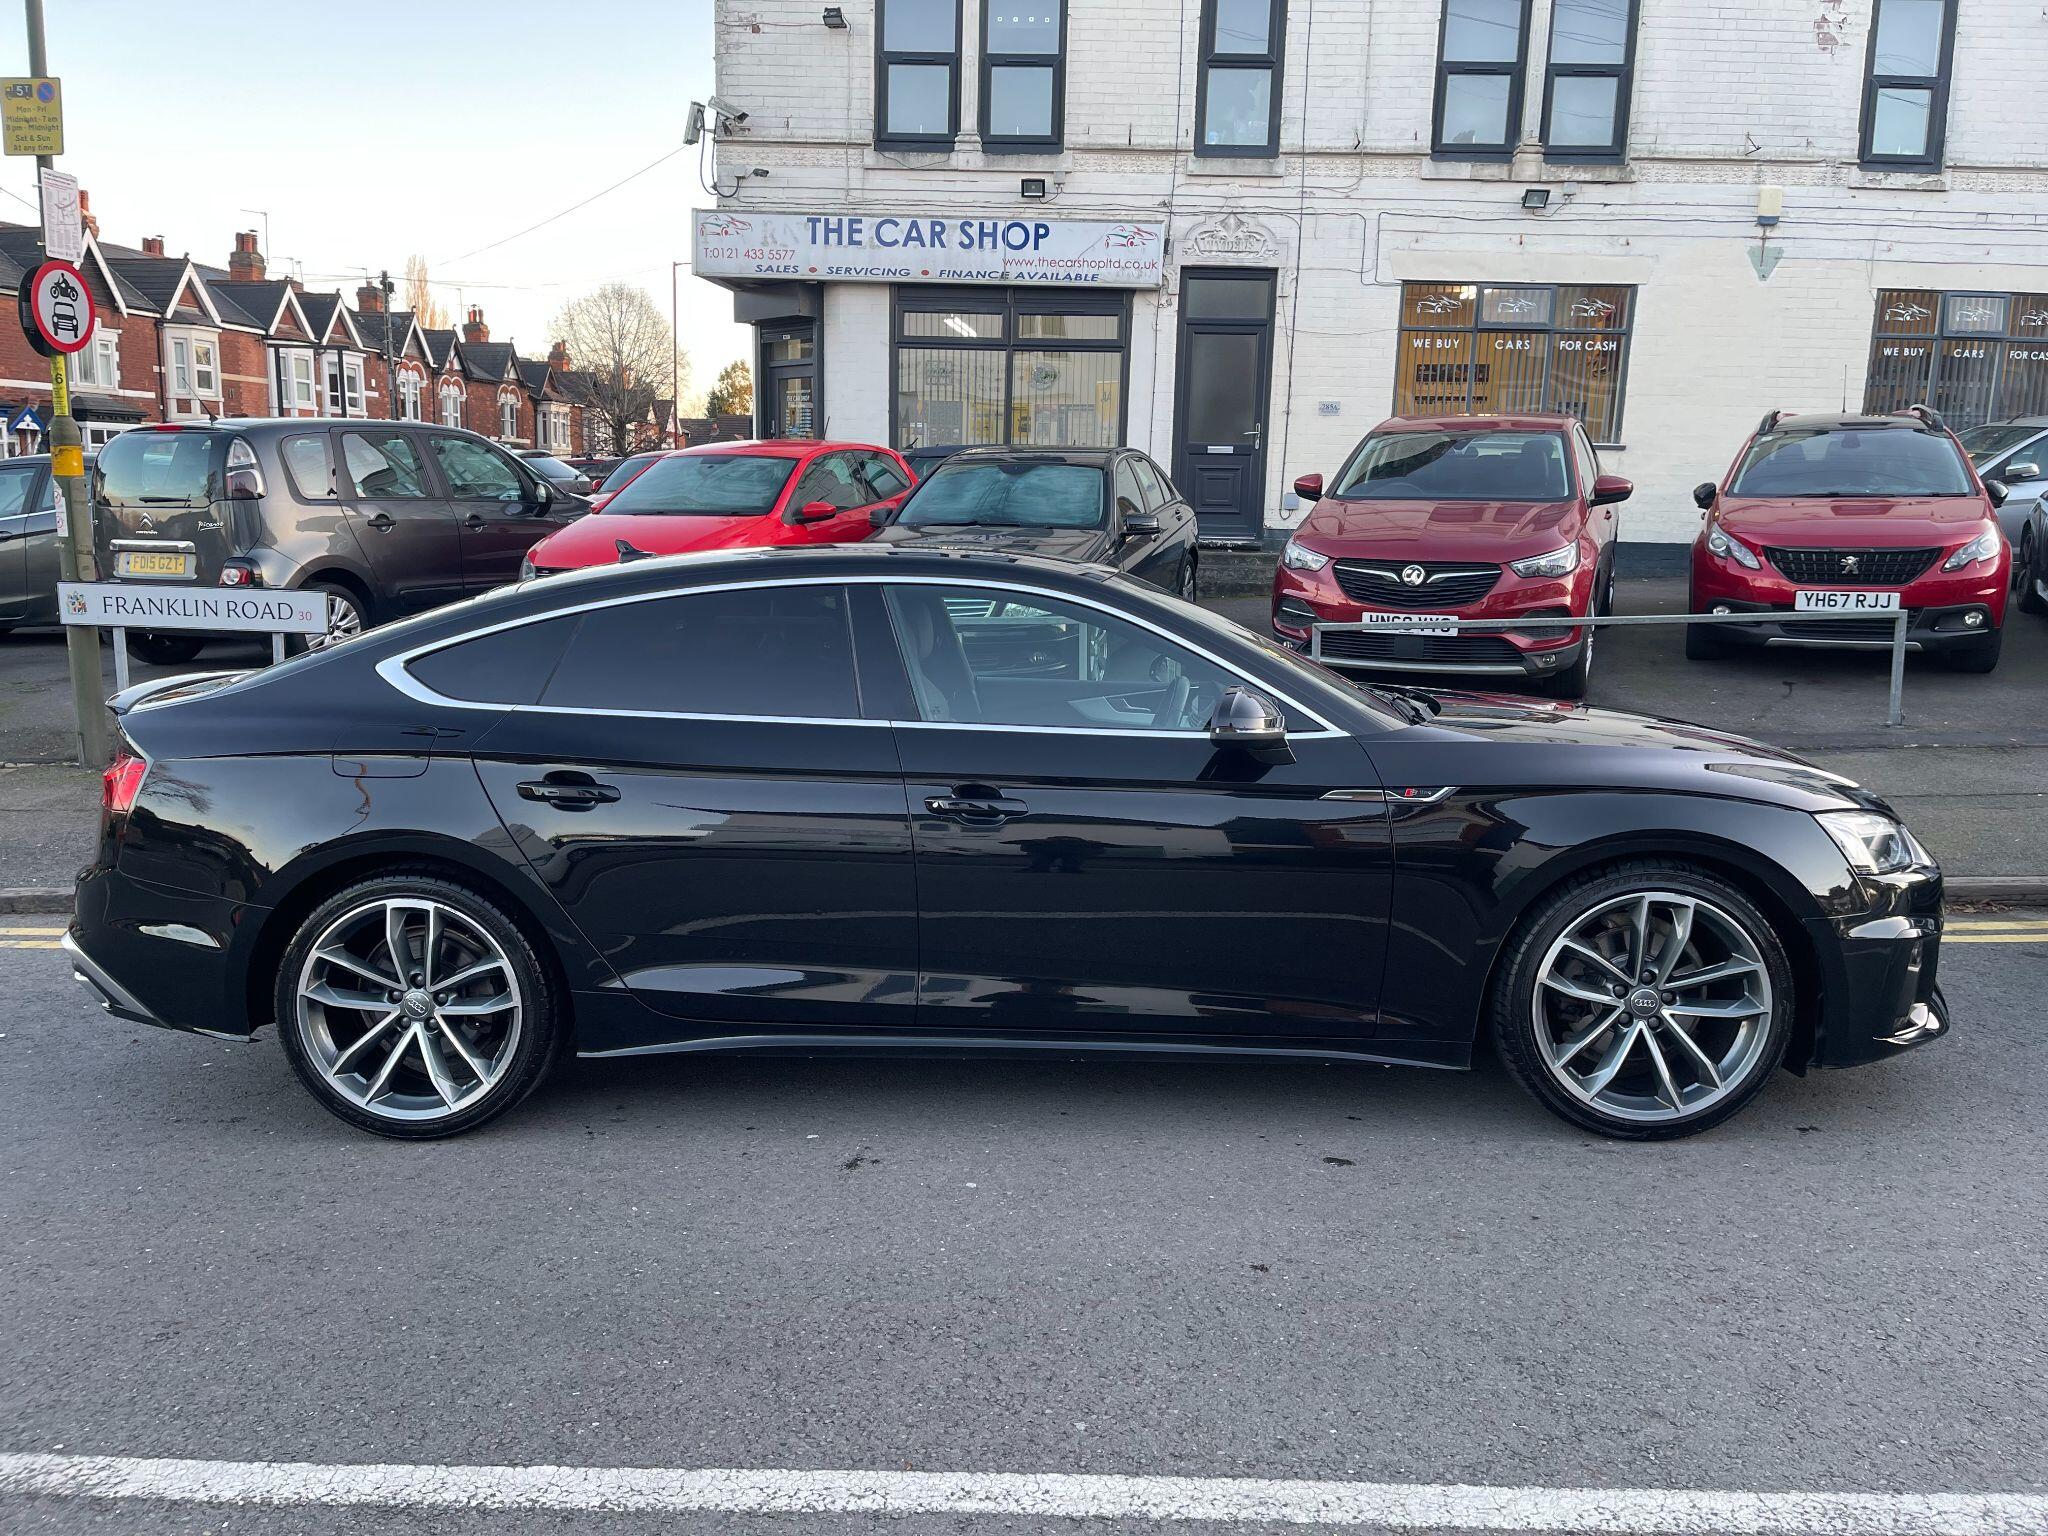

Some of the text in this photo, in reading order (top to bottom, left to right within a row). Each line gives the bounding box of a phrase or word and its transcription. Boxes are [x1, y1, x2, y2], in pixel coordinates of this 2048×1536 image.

[806, 217, 863, 246] THE
[875, 219, 947, 249] CAR
[959, 221, 1050, 251] SHOP
[703, 248, 796, 260] T:0121 433 5577
[1002, 257, 1158, 272] www.thecarshopltd.co.uk
[755, 264, 1100, 282] SALES SERVICING FINANCE AVAILABLE
[1413, 338, 1617, 351] WE BUY CARS FOR CASH
[1883, 348, 1899, 356] WE
[1904, 348, 1926, 357] BUY
[1953, 349, 1985, 359] CARS
[2009, 350, 2028, 360] FOR
[55, 373, 63, 384] 6
[133, 557, 180, 570] FD15 GZT
[1804, 593, 1891, 609] YH67 RJJ
[102, 596, 312, 621] FRANKLIN ROAD 30
